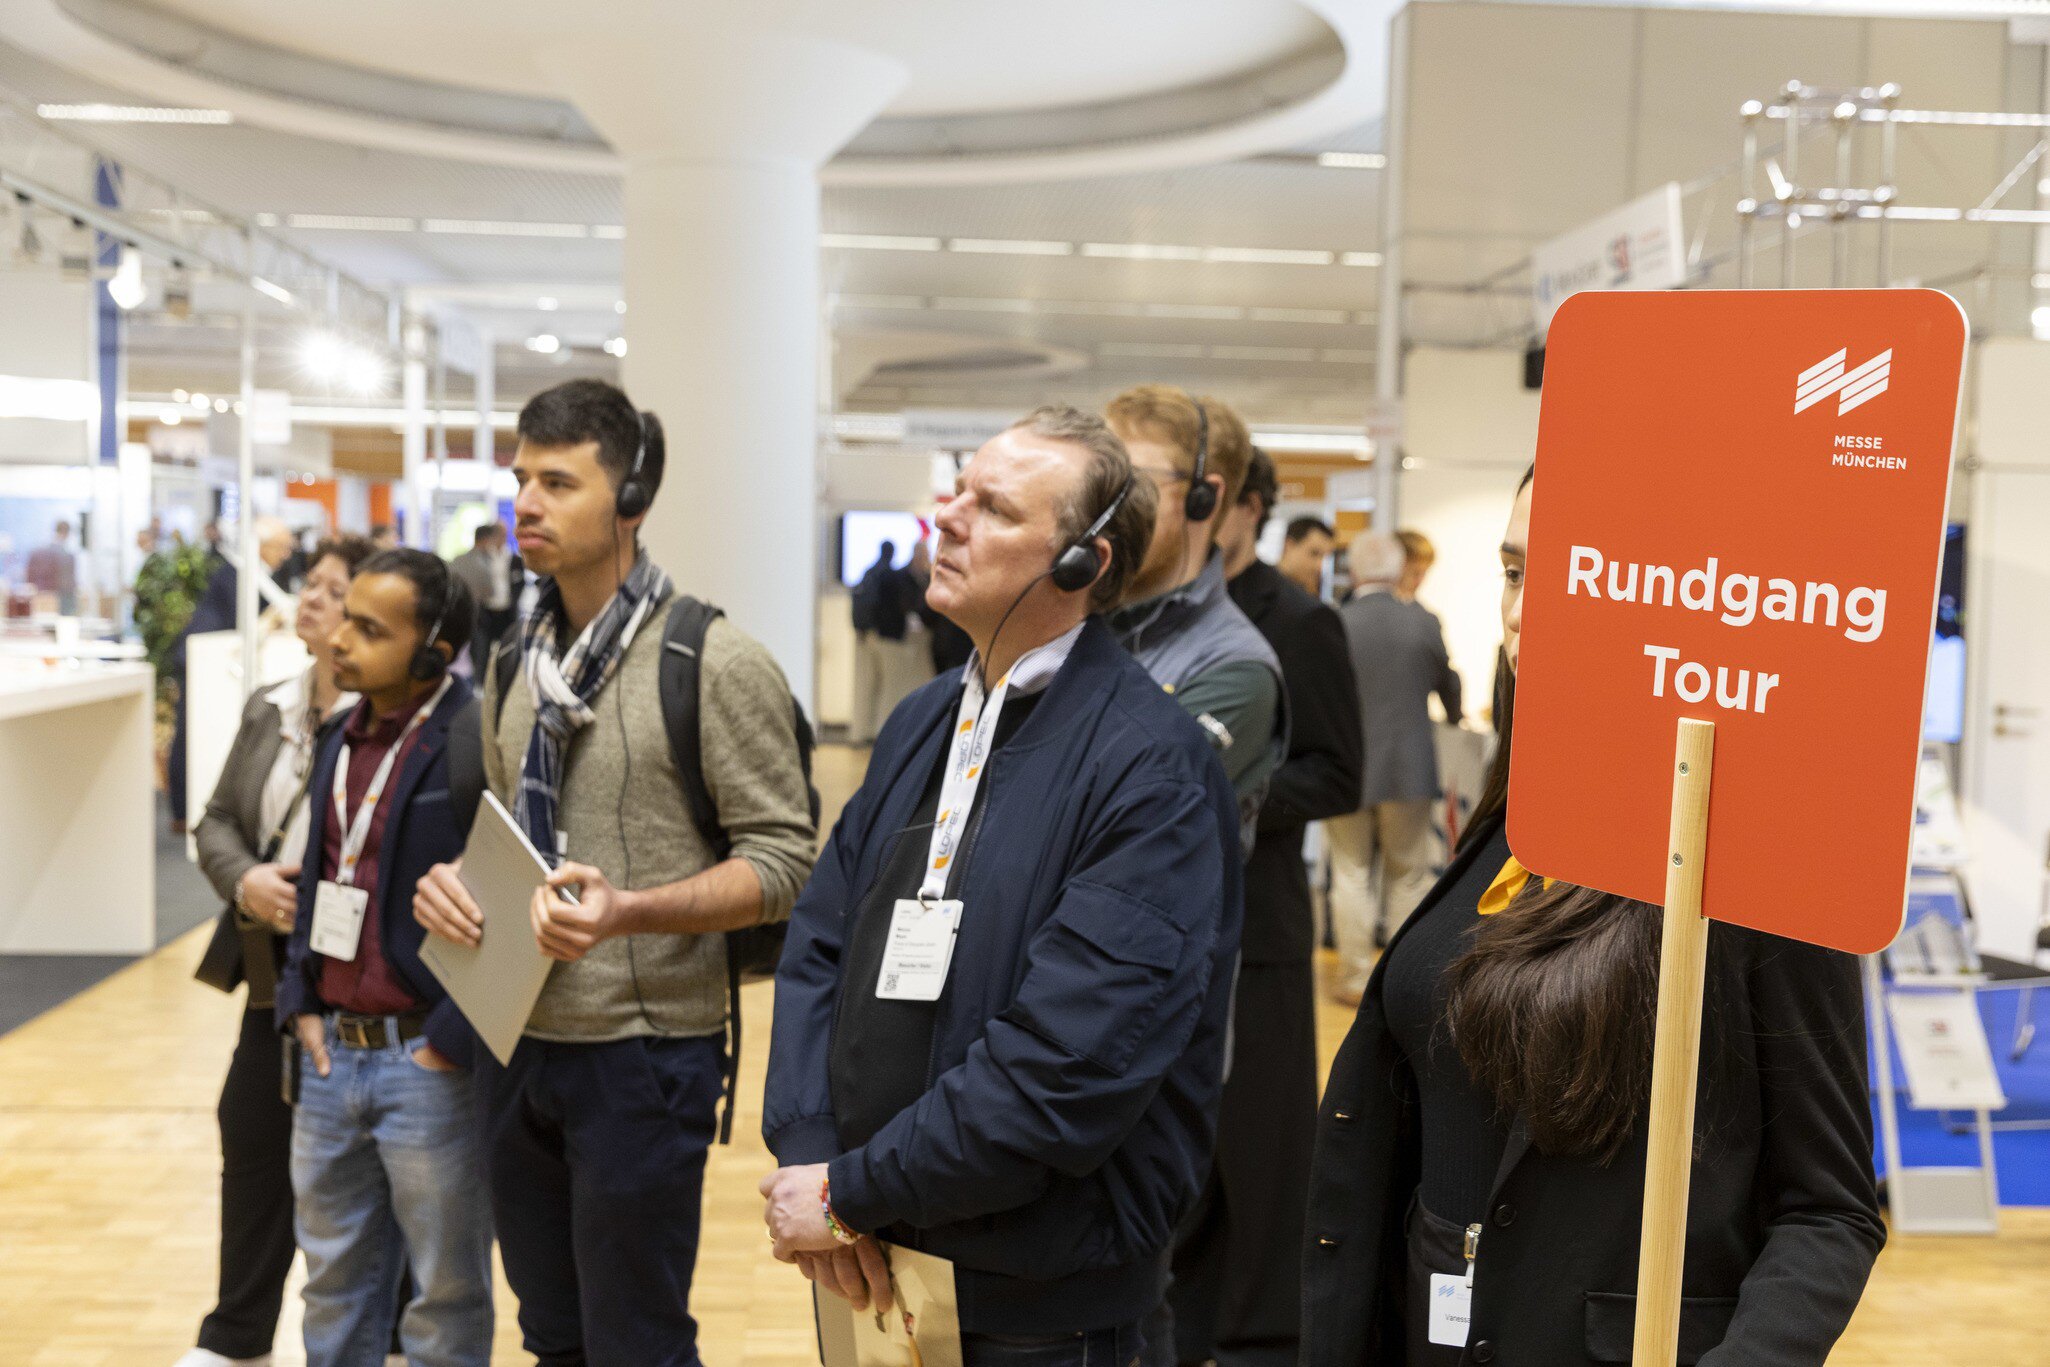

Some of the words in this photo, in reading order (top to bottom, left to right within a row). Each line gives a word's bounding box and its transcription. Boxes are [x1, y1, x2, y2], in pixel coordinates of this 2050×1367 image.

[1832, 452, 1907, 469] MÜNCHEN
[1834, 435, 1883, 449] MESSE
[1567, 545, 1887, 643] Rundgang
[1643, 644, 1780, 714] Tour
[972, 714, 992, 766] LOPEC
[938, 805, 962, 855] LOPEC
